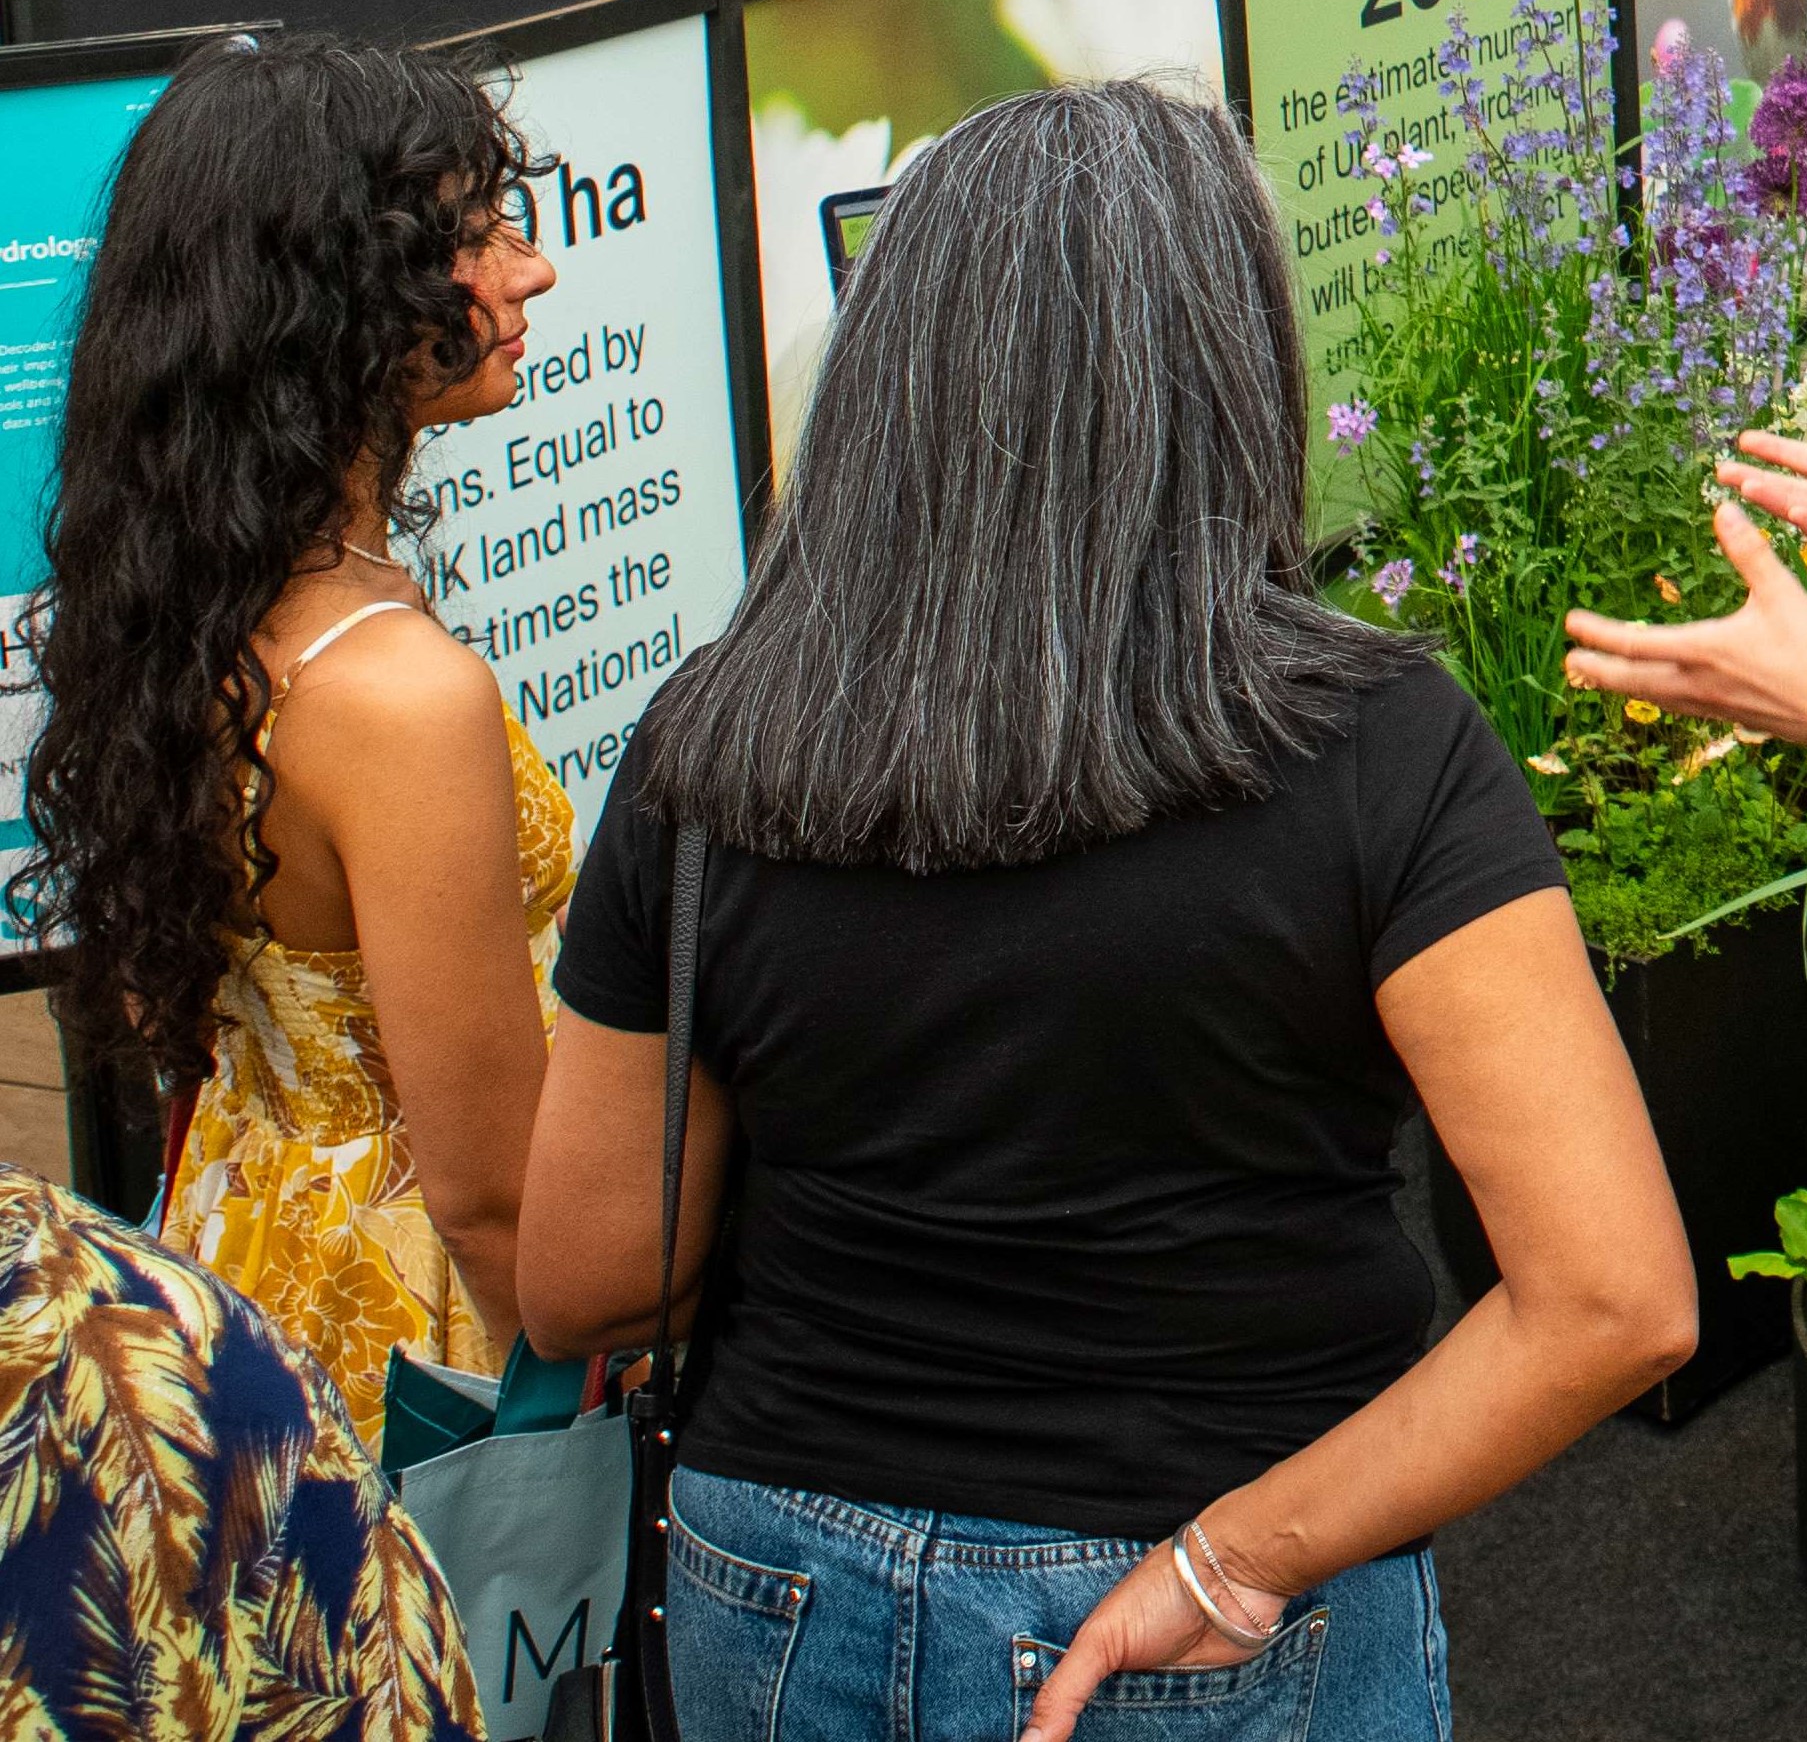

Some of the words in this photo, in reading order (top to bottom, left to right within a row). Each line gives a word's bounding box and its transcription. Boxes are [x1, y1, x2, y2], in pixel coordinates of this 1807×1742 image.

[1280, 88, 1327, 132] the
[558, 160, 648, 250] ha
[1298, 146, 1327, 192] of
[603, 322, 646, 375] by
[507, 402, 619, 494] Equal
[626, 394, 665, 439] to
[479, 502, 566, 585] land
[578, 468, 682, 545] mass
[486, 591, 600, 665] times
[608, 550, 673, 610] the
[518, 613, 683, 727] National
